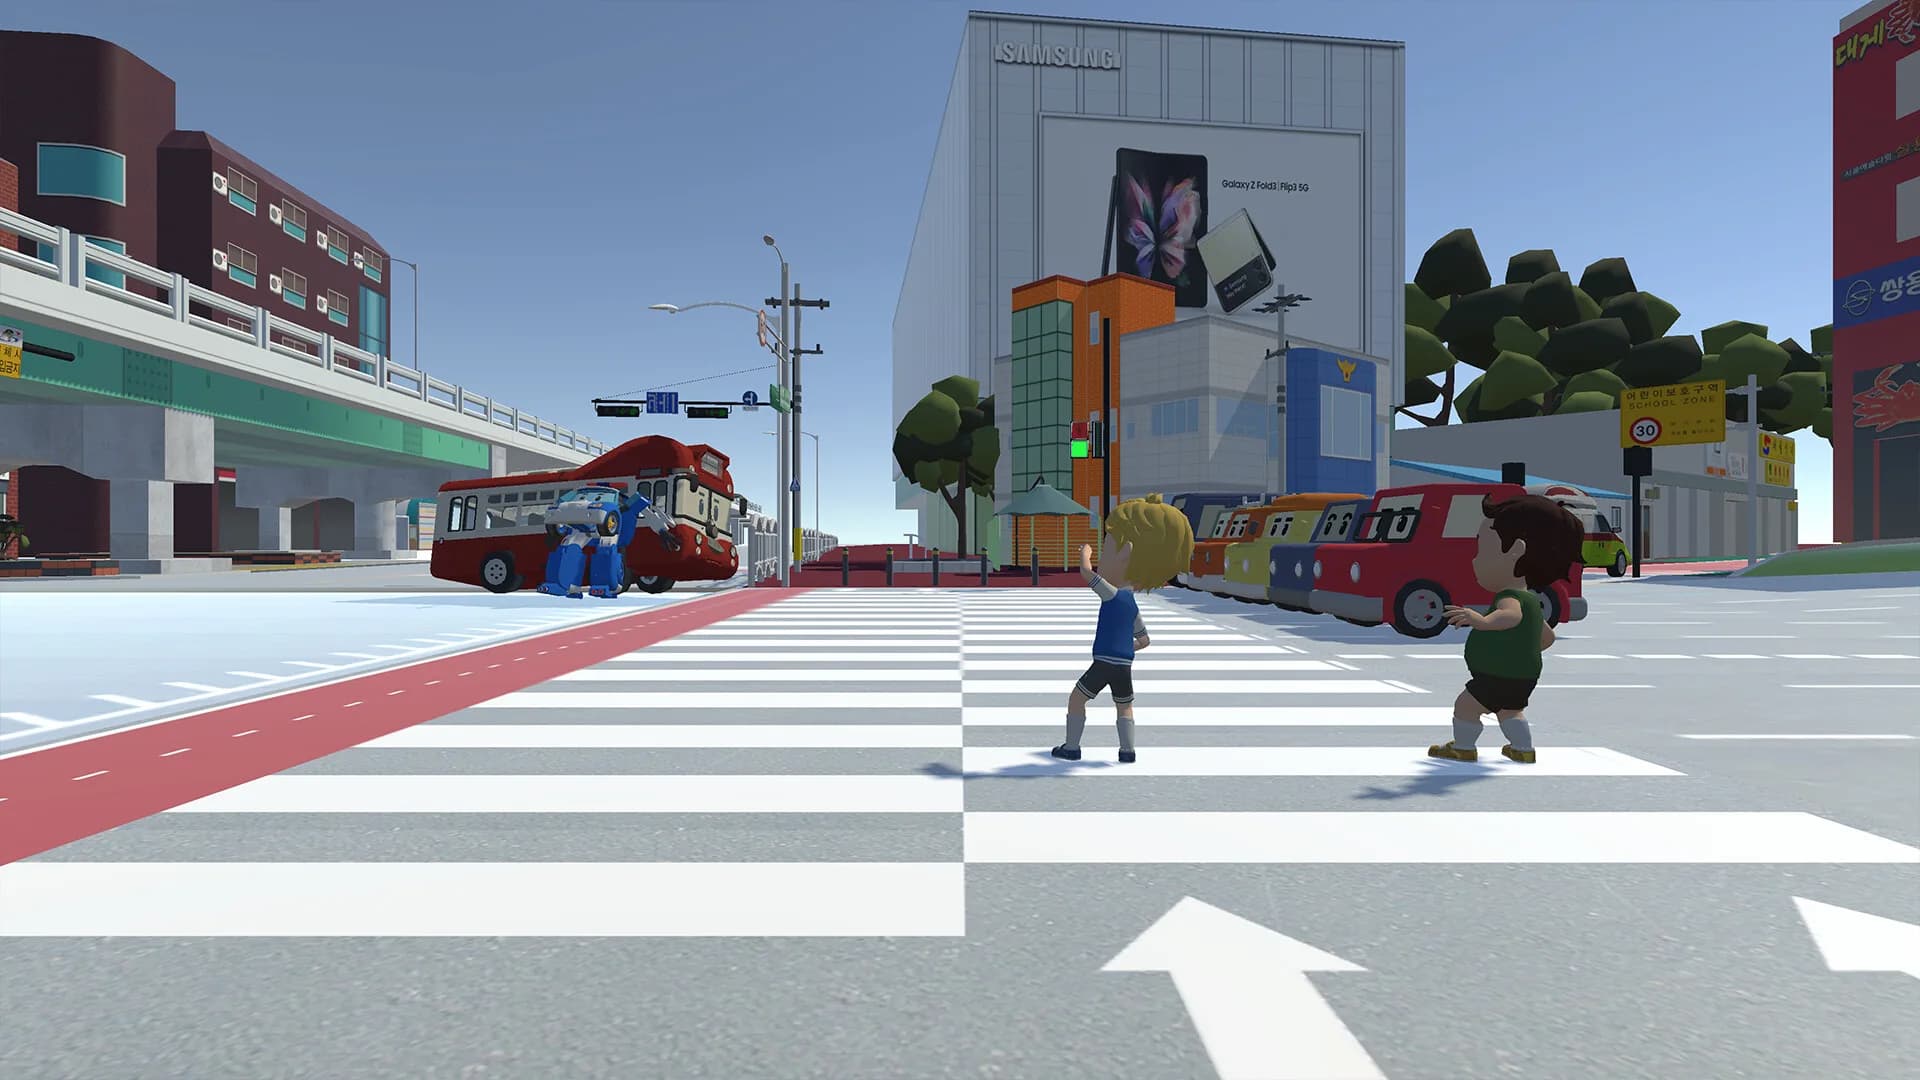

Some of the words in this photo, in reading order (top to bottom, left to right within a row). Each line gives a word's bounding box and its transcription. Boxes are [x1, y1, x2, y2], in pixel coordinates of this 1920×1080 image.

[1000, 42, 1115, 70] SAMSUNG
[1222, 179, 1250, 191] Galaxy
[1250, 181, 1256, 190] Z
[1256, 180, 1277, 191] Fold3
[1280, 181, 1297, 193] Flip3
[1298, 183, 1310, 192] 5G
[1629, 399, 1677, 410] SCHOOL
[1682, 395, 1716, 406] ZONE
[1635, 424, 1656, 438] 30
